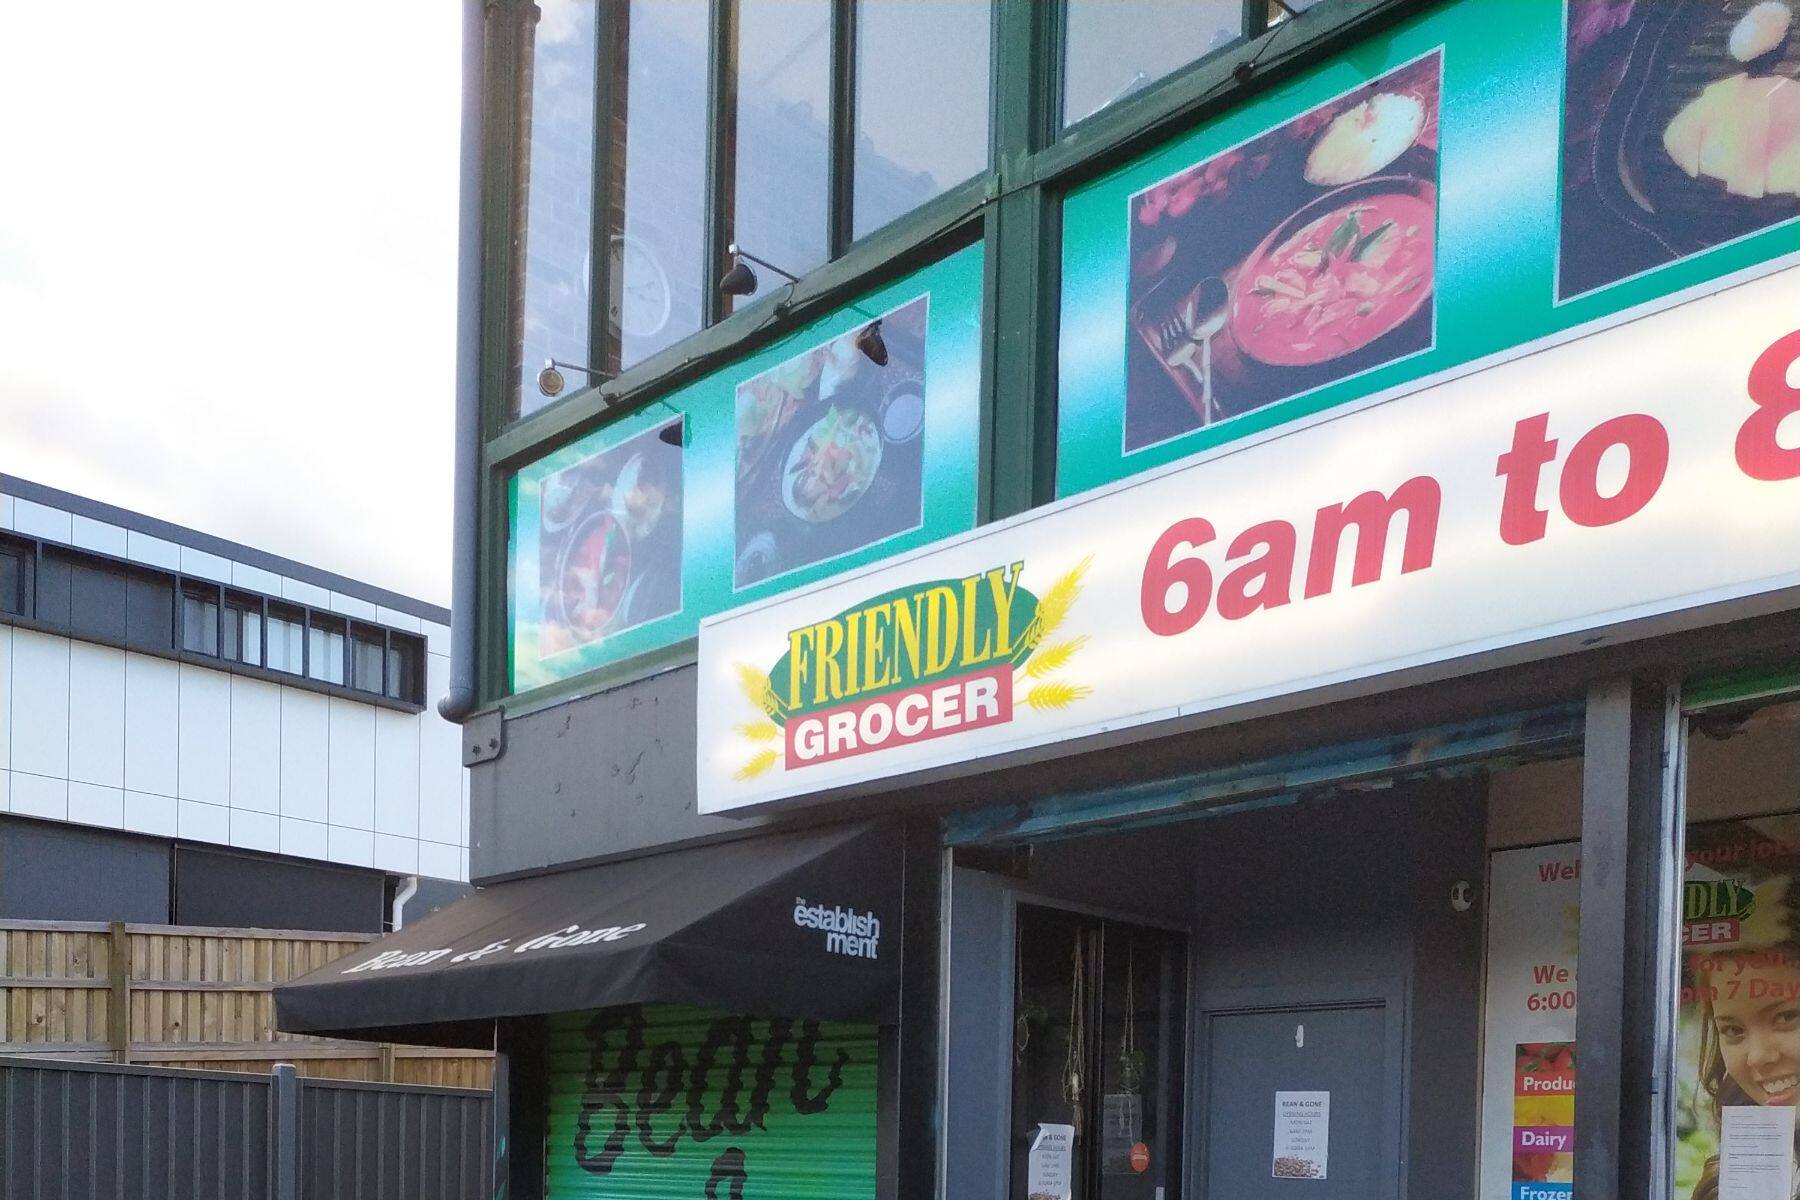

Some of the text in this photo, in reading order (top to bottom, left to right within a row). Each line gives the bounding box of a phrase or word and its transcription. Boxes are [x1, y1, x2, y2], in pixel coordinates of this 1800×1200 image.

[1141, 476, 1442, 637] 6am
[1495, 412, 1670, 546] to
[787, 560, 1024, 711] FRIENDLY
[794, 676, 1000, 760] GROCER
[1538, 859, 1581, 881] Wel
[1686, 879, 1745, 920] DLY
[794, 904, 880, 939] establish
[1682, 921, 1732, 943] ER
[340, 948, 453, 974] Bean
[514, 923, 647, 954] Gone
[826, 932, 878, 959] ment
[1533, 965, 1569, 984] We
[1527, 990, 1579, 1012] 6:00
[1521, 1131, 1567, 1149] Dairy
